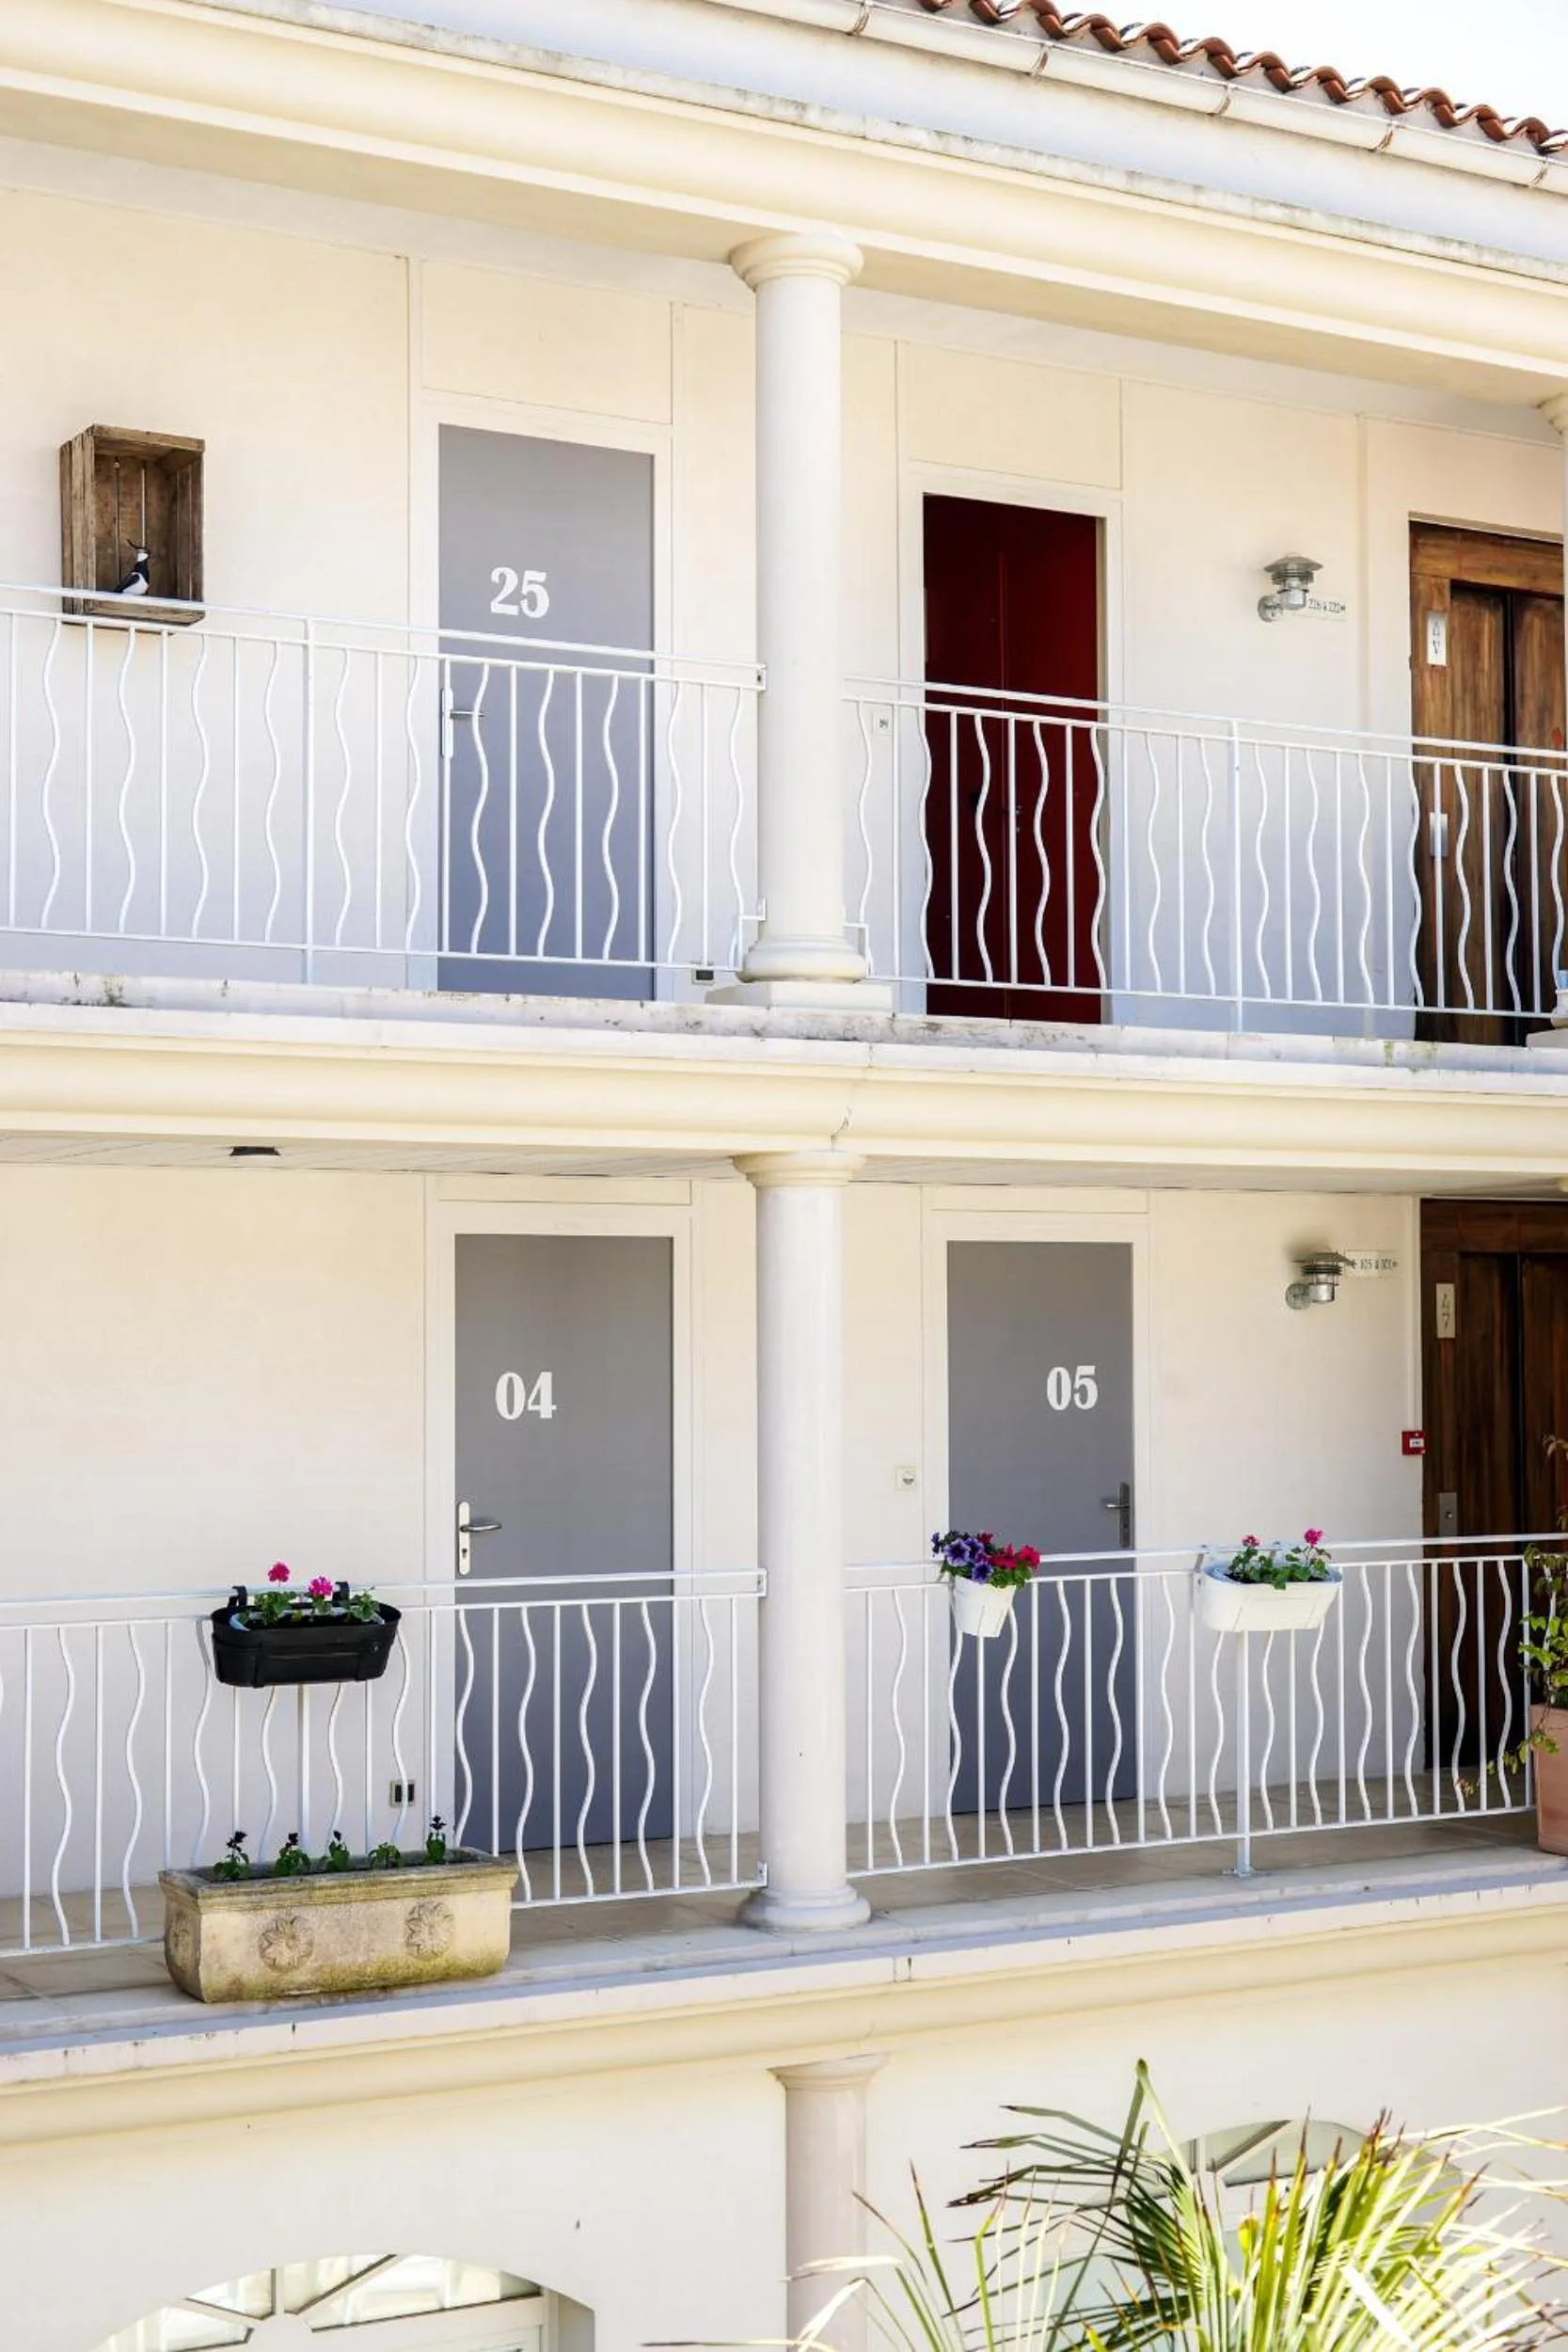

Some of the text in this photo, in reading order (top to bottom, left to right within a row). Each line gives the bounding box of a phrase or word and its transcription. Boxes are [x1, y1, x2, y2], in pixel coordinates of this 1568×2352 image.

[490, 566, 549, 618] 25
[496, 1372, 557, 1420] 04
[1047, 1365, 1098, 1410] 05
